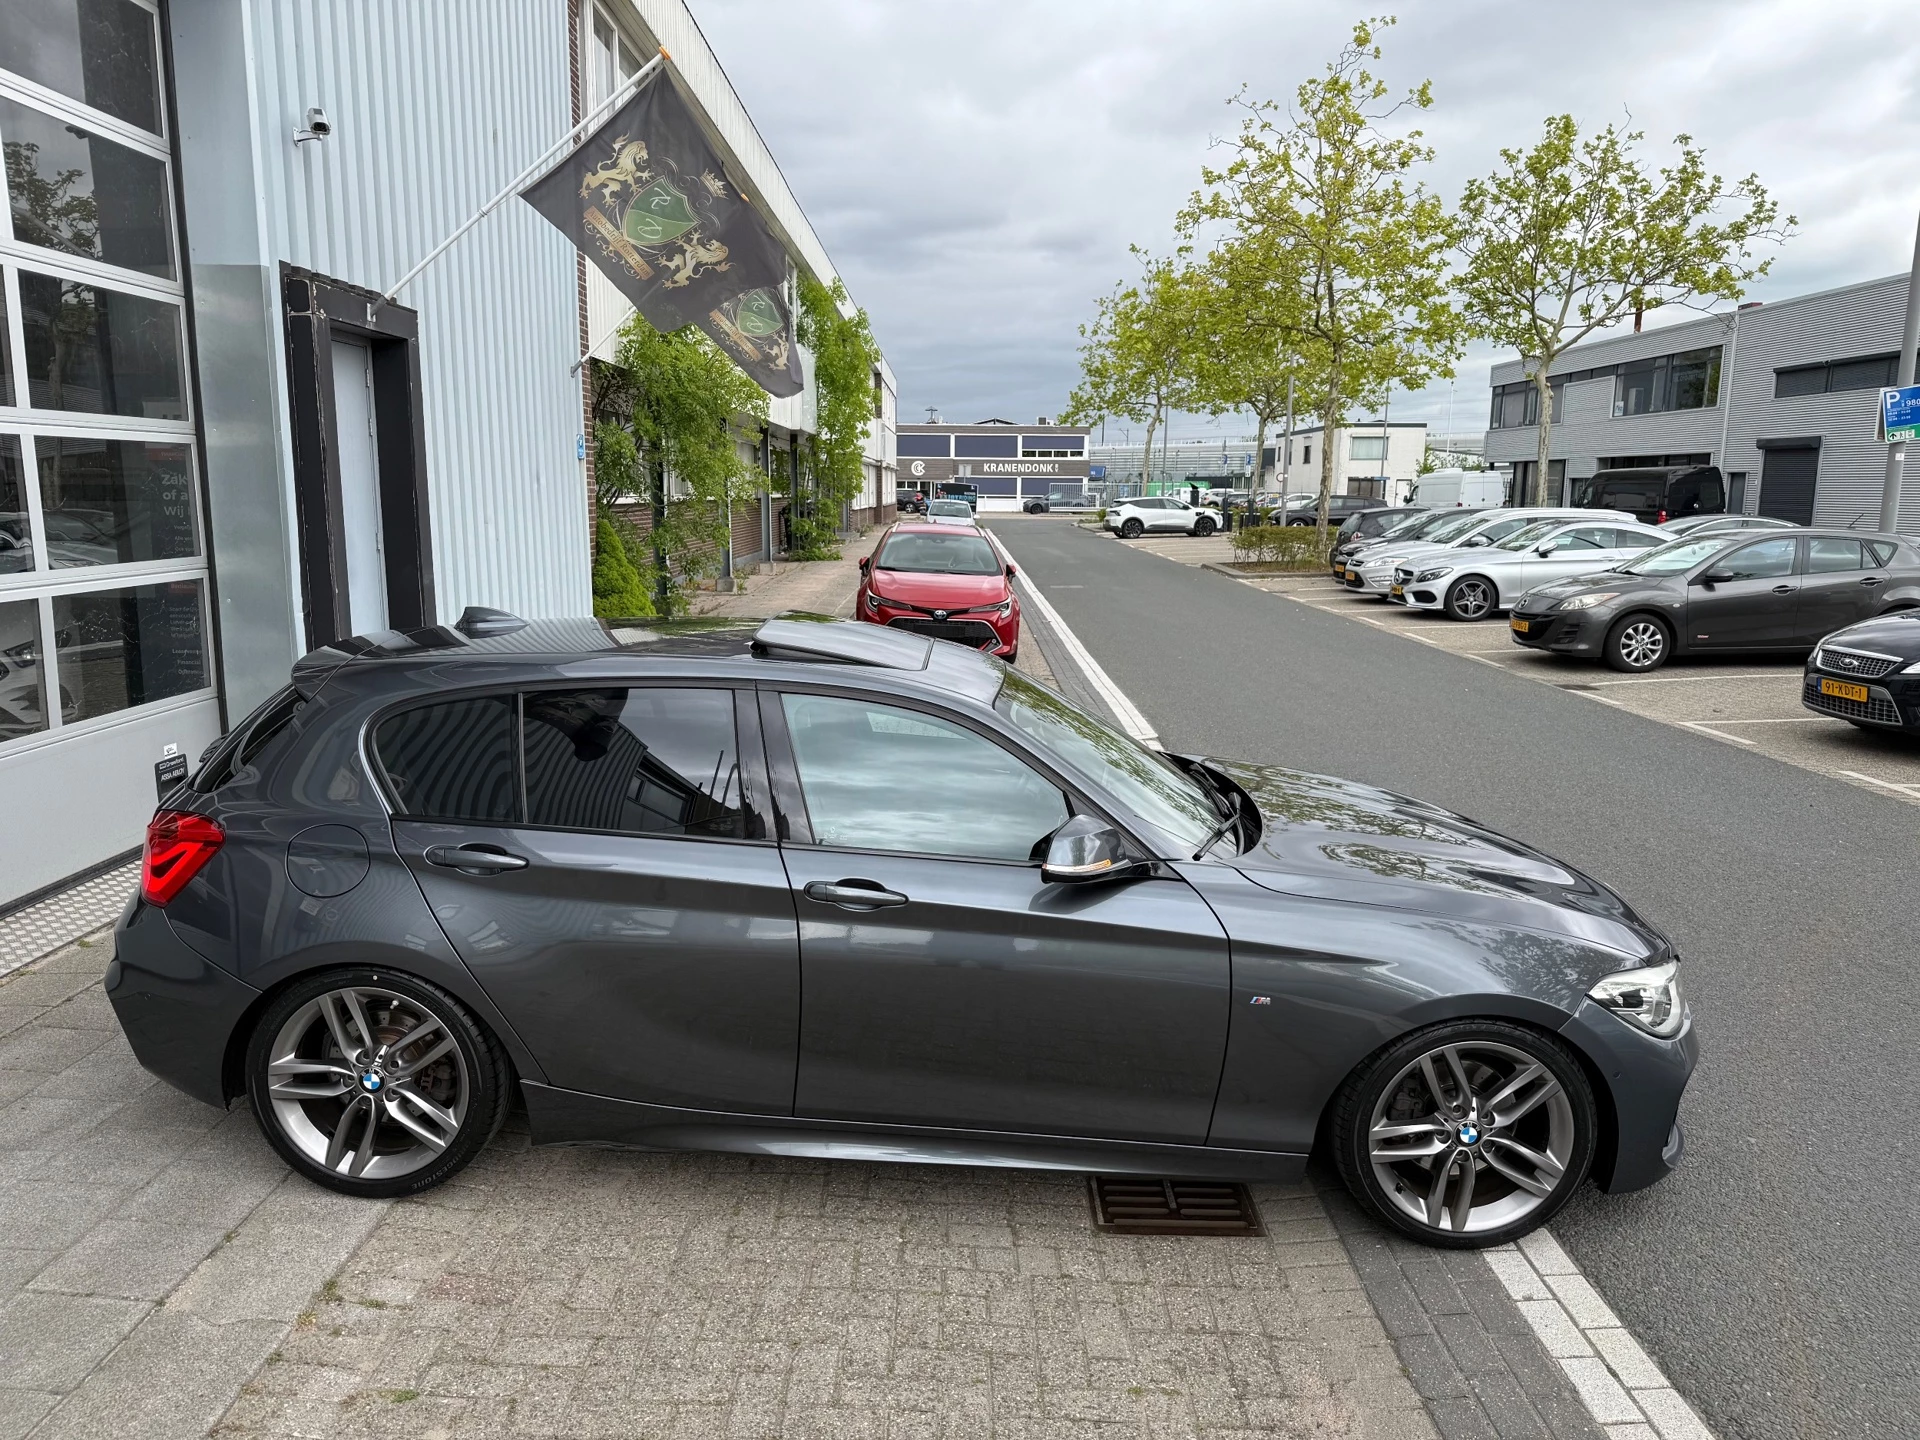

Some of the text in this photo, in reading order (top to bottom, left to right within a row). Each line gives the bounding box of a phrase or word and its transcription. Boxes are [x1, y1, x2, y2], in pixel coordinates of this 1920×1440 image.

[589, 211, 650, 275] Autobedrijf Rotterdam
[1886, 391, 1900, 408] P
[983, 463, 1053, 473] KRANENDONK
[162, 490, 177, 500] of
[164, 505, 184, 518] Wij
[161, 772, 173, 782] ASSA
